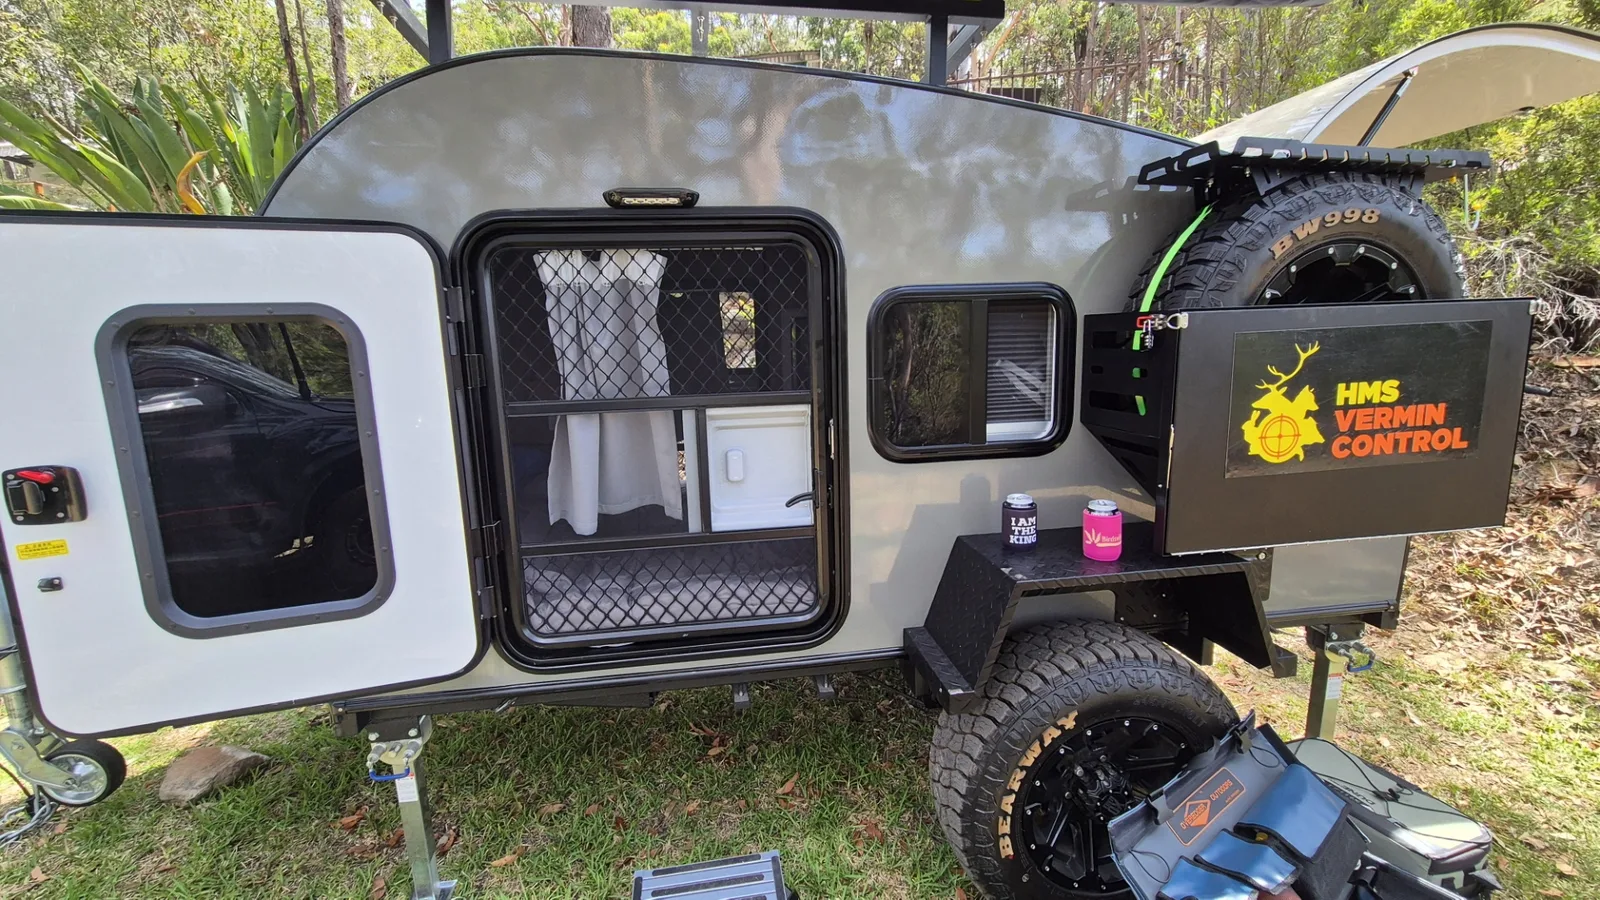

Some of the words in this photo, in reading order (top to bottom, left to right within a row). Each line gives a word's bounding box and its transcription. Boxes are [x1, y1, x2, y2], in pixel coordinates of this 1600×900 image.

[1336, 379, 1401, 406] HMS
[1334, 402, 1447, 433] VERMIN
[1331, 427, 1469, 459] CONTROL
[1011, 517, 1016, 526] I
[1017, 516, 1036, 527] AM
[1011, 526, 1036, 536] THE
[1009, 534, 1037, 545] KING
[998, 709, 1079, 859] BEARWAY
[1209, 779, 1233, 801] OUTDOORS
